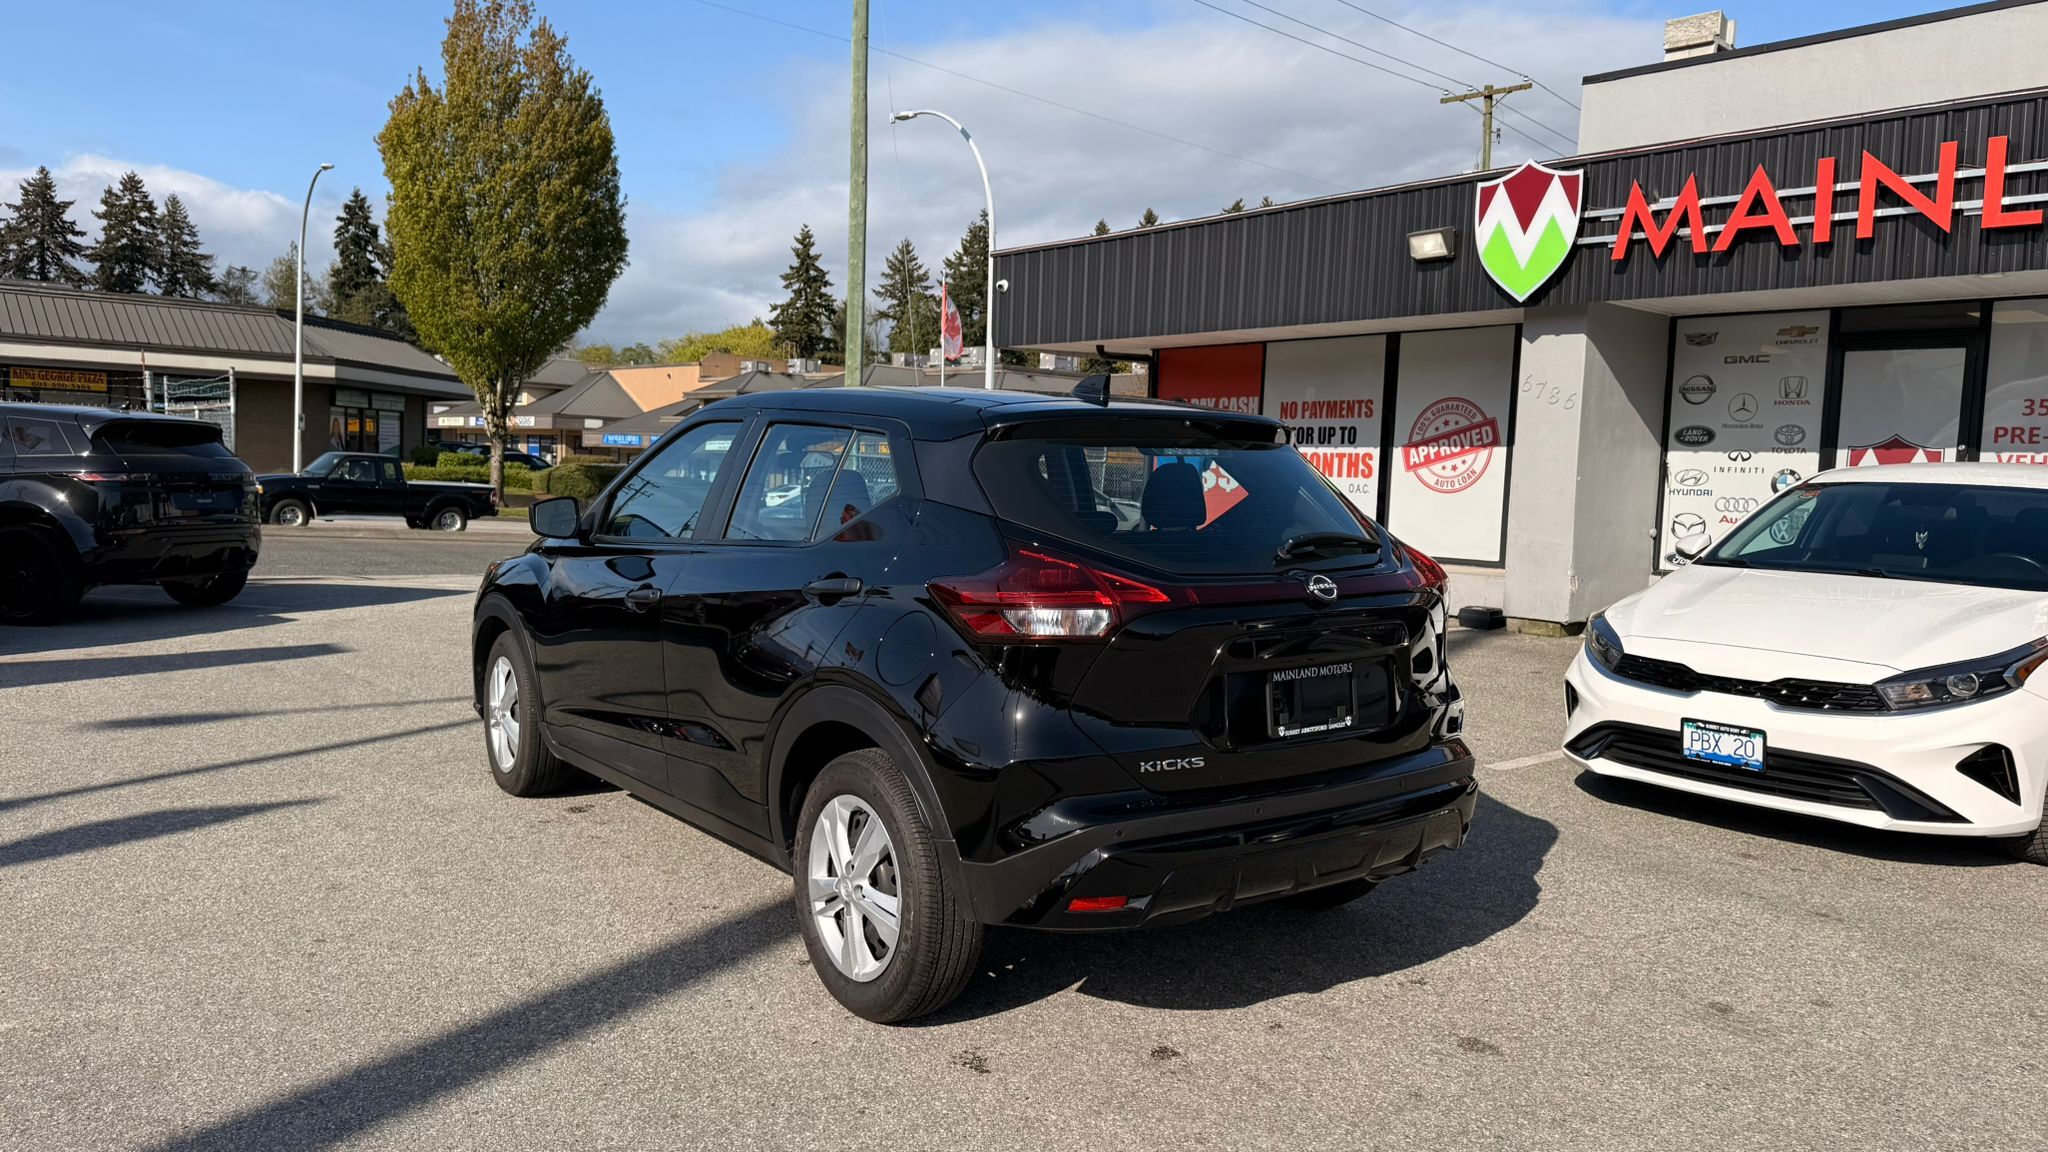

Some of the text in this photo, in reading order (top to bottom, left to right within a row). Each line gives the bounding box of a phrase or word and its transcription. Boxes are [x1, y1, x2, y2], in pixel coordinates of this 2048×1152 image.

[1610, 135, 2044, 260] MAINL
[1724, 354, 1770, 364] GMC
[13, 367, 104, 384] KING GEORGE PIZZA
[1521, 374, 1577, 410] 6786
[1219, 396, 1259, 415] CASH
[1280, 399, 1374, 419] NO PAYMENTS
[1415, 403, 1477, 436] 100% GUARANTEED
[1294, 426, 1357, 444] OR UP TO
[1409, 425, 1493, 466] APPROVED
[1304, 452, 1373, 479] ONTHS
[1713, 466, 1765, 475] INFINITI
[1434, 468, 1478, 489] AUTO LOAN
[1669, 488, 1713, 497] HYUNDAI
[1308, 583, 1338, 591] NISSAN
[1273, 663, 1353, 682] MAINLAND MOTORS
[1690, 731, 1756, 758] PBX 20
[1140, 756, 1206, 773] KICKS
